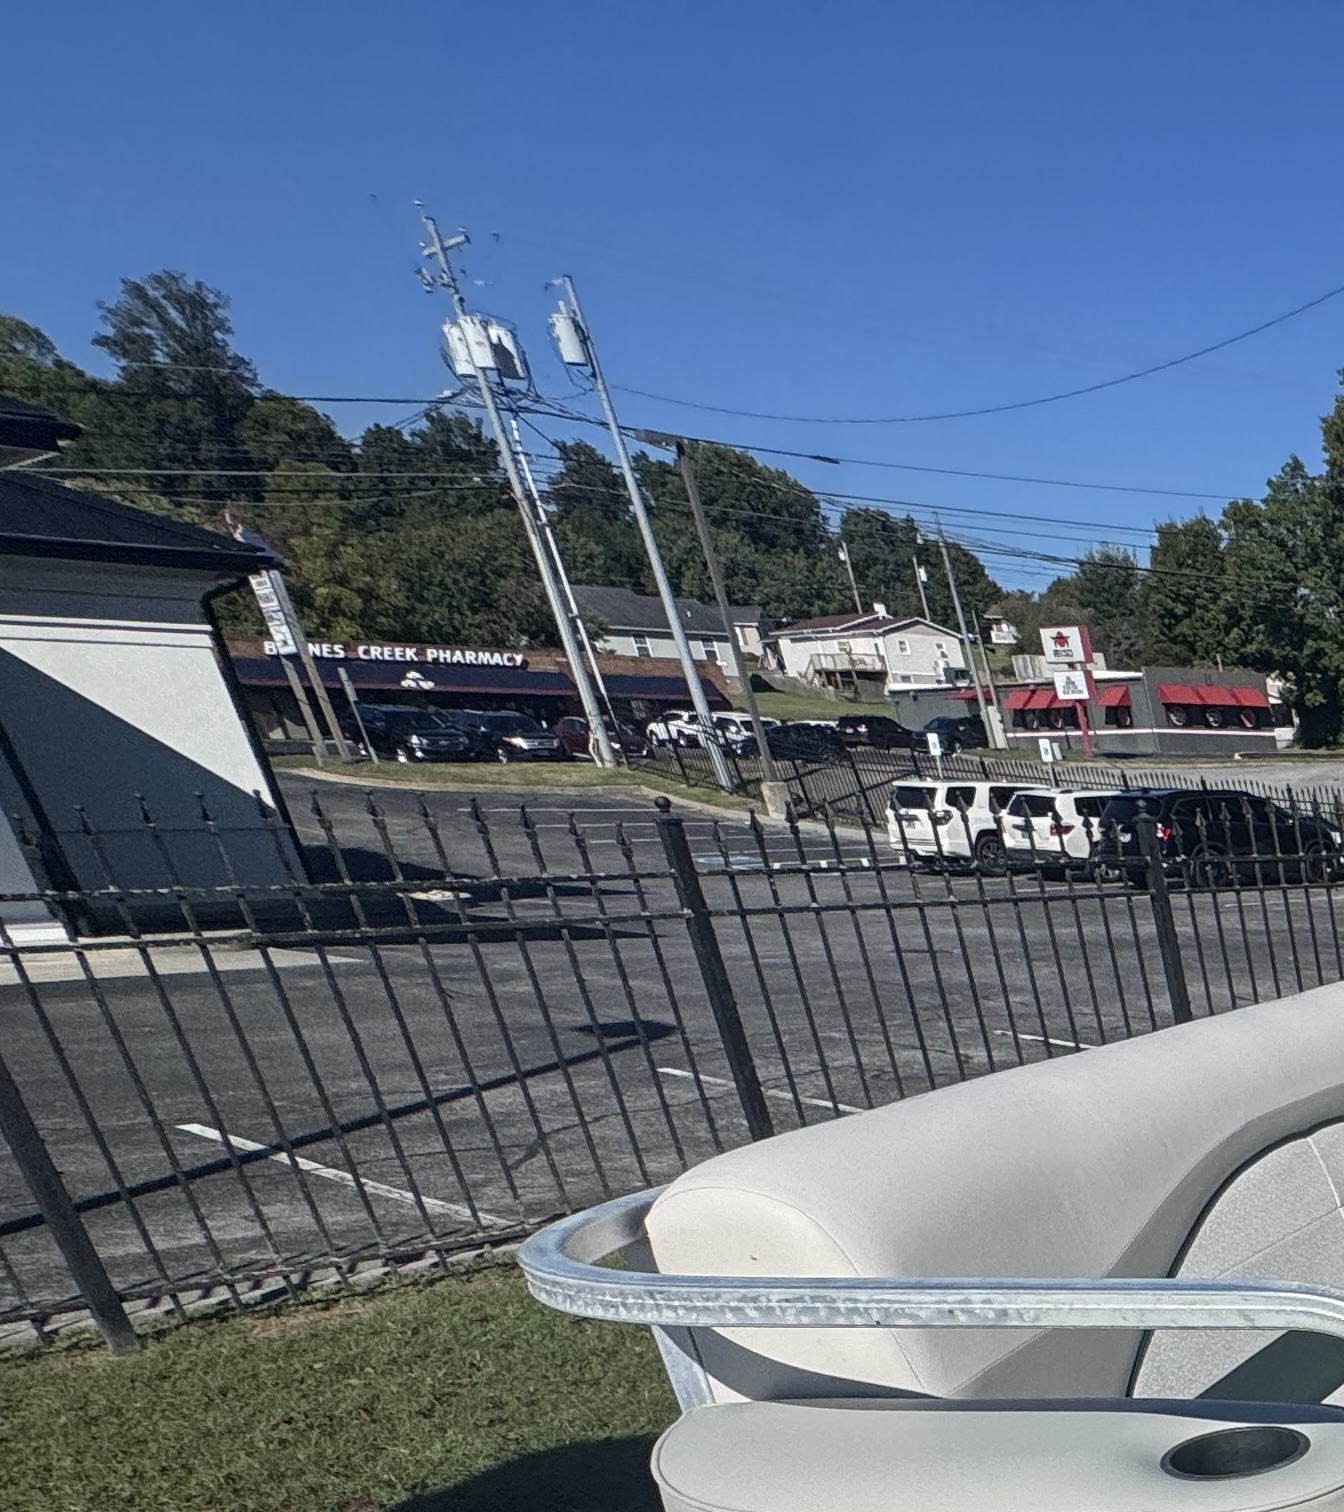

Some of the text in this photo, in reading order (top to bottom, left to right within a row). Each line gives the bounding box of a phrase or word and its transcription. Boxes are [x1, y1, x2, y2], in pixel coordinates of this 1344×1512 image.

[263, 640, 524, 667] BNES CREEK PHARMACY
